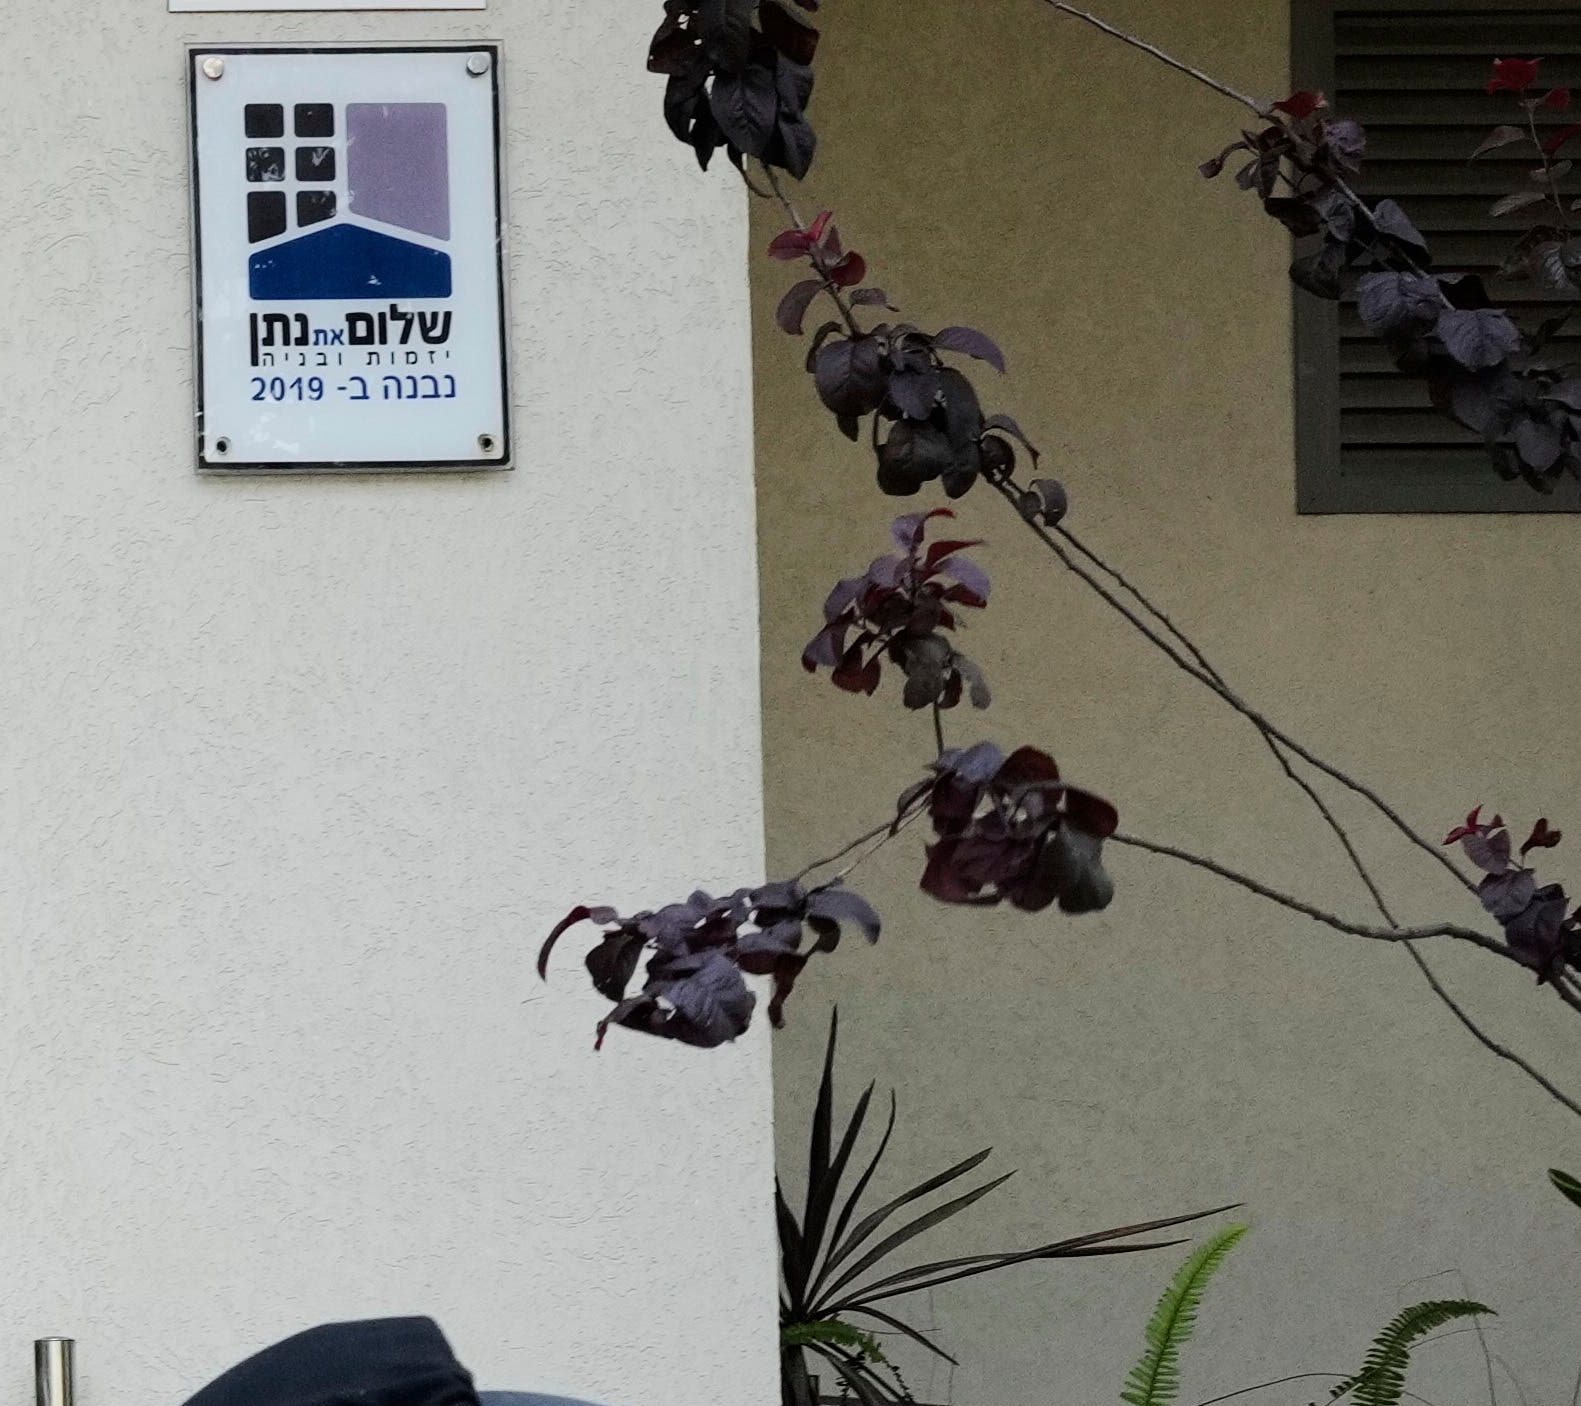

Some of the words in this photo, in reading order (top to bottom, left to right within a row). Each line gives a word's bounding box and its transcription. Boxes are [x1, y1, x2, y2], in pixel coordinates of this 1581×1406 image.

[313, 328, 345, 346] את
[345, 303, 452, 346] שלום
[249, 312, 309, 367] נתן
[262, 352, 343, 367] ובניה
[366, 350, 450, 366] יזמות
[250, 376, 324, 401] 2019
[382, 374, 456, 400] נבנה
